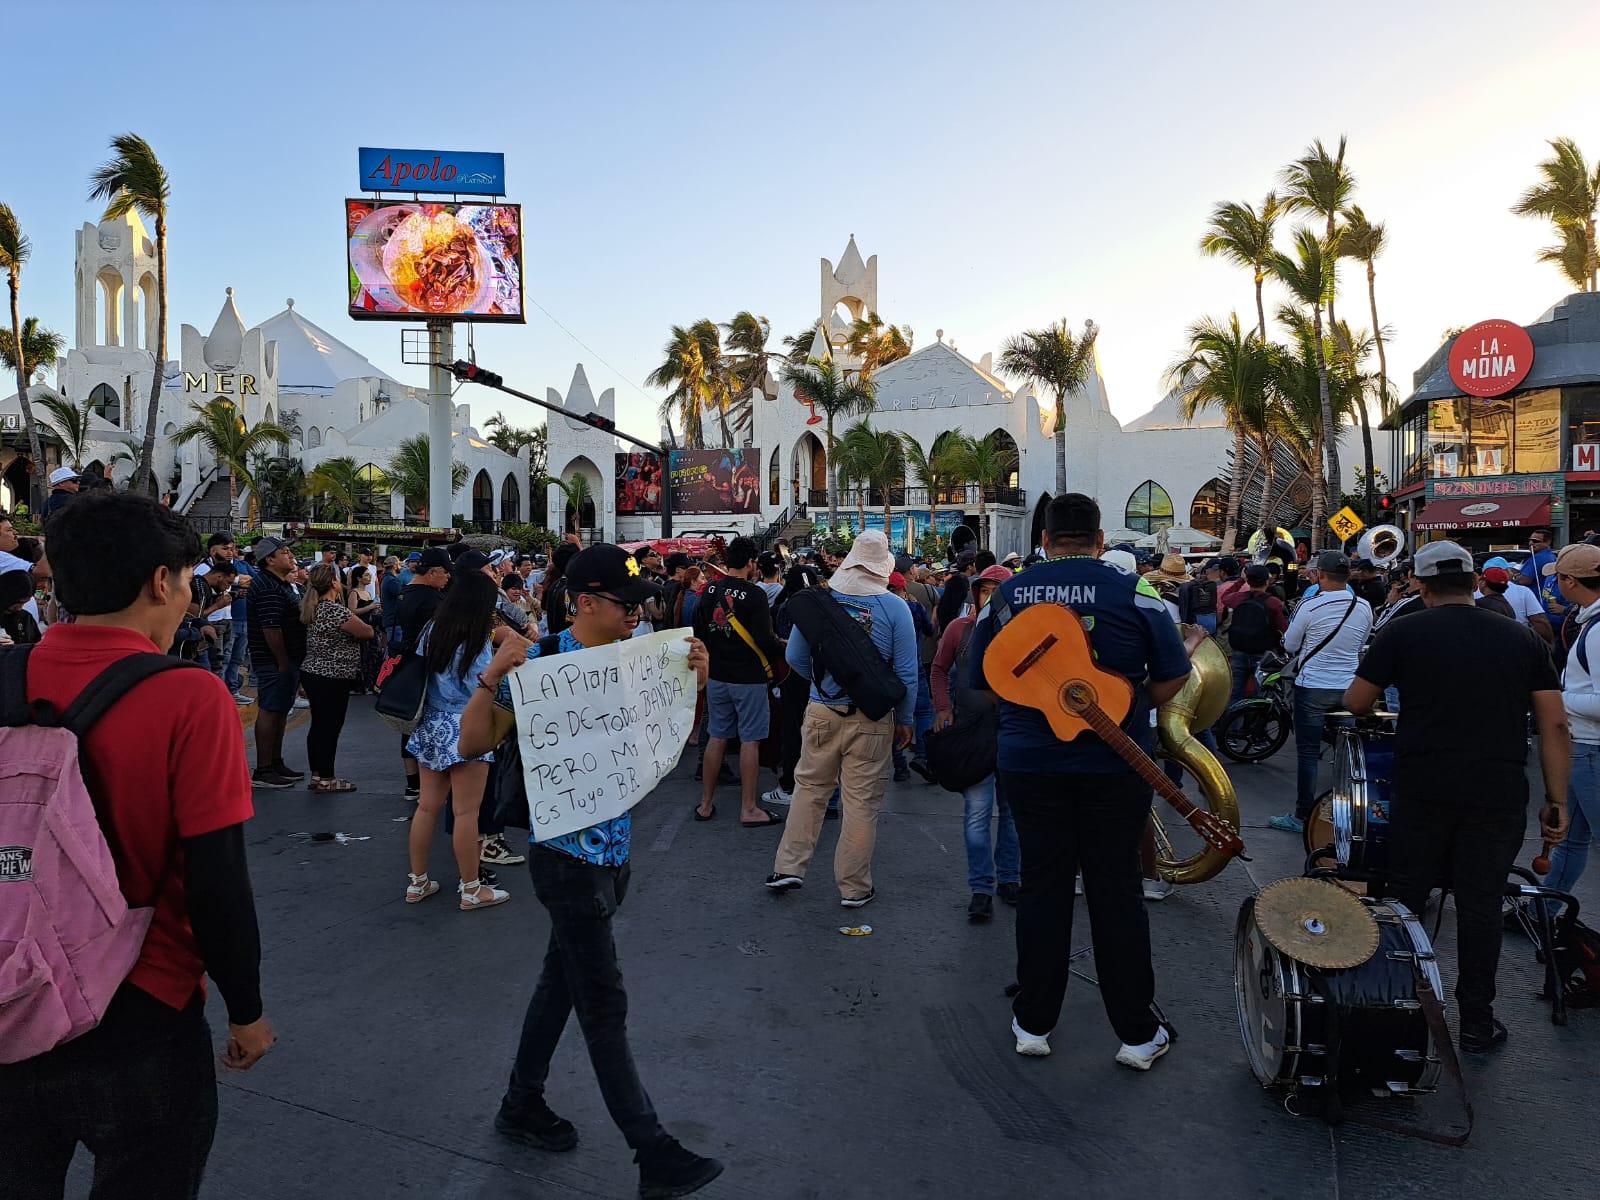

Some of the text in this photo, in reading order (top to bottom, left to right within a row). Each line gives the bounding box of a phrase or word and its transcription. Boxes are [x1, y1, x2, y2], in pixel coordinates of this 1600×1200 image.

[368, 154, 457, 187] Apolo
[1481, 338, 1499, 355] LA
[1463, 355, 1516, 379] MONA
[182, 371, 259, 395] MER
[1523, 479, 1555, 492] ONLY
[1416, 522, 1458, 530] VALENTINO
[1466, 521, 1491, 529] PIZZA
[708, 585, 747, 600] GESS
[1013, 585, 1096, 605] SHERMAN
[514, 671, 558, 706] LA
[639, 655, 653, 681] LA
[639, 677, 685, 717] BANDA
[566, 706, 594, 737] DE
[530, 752, 597, 792] PERO
